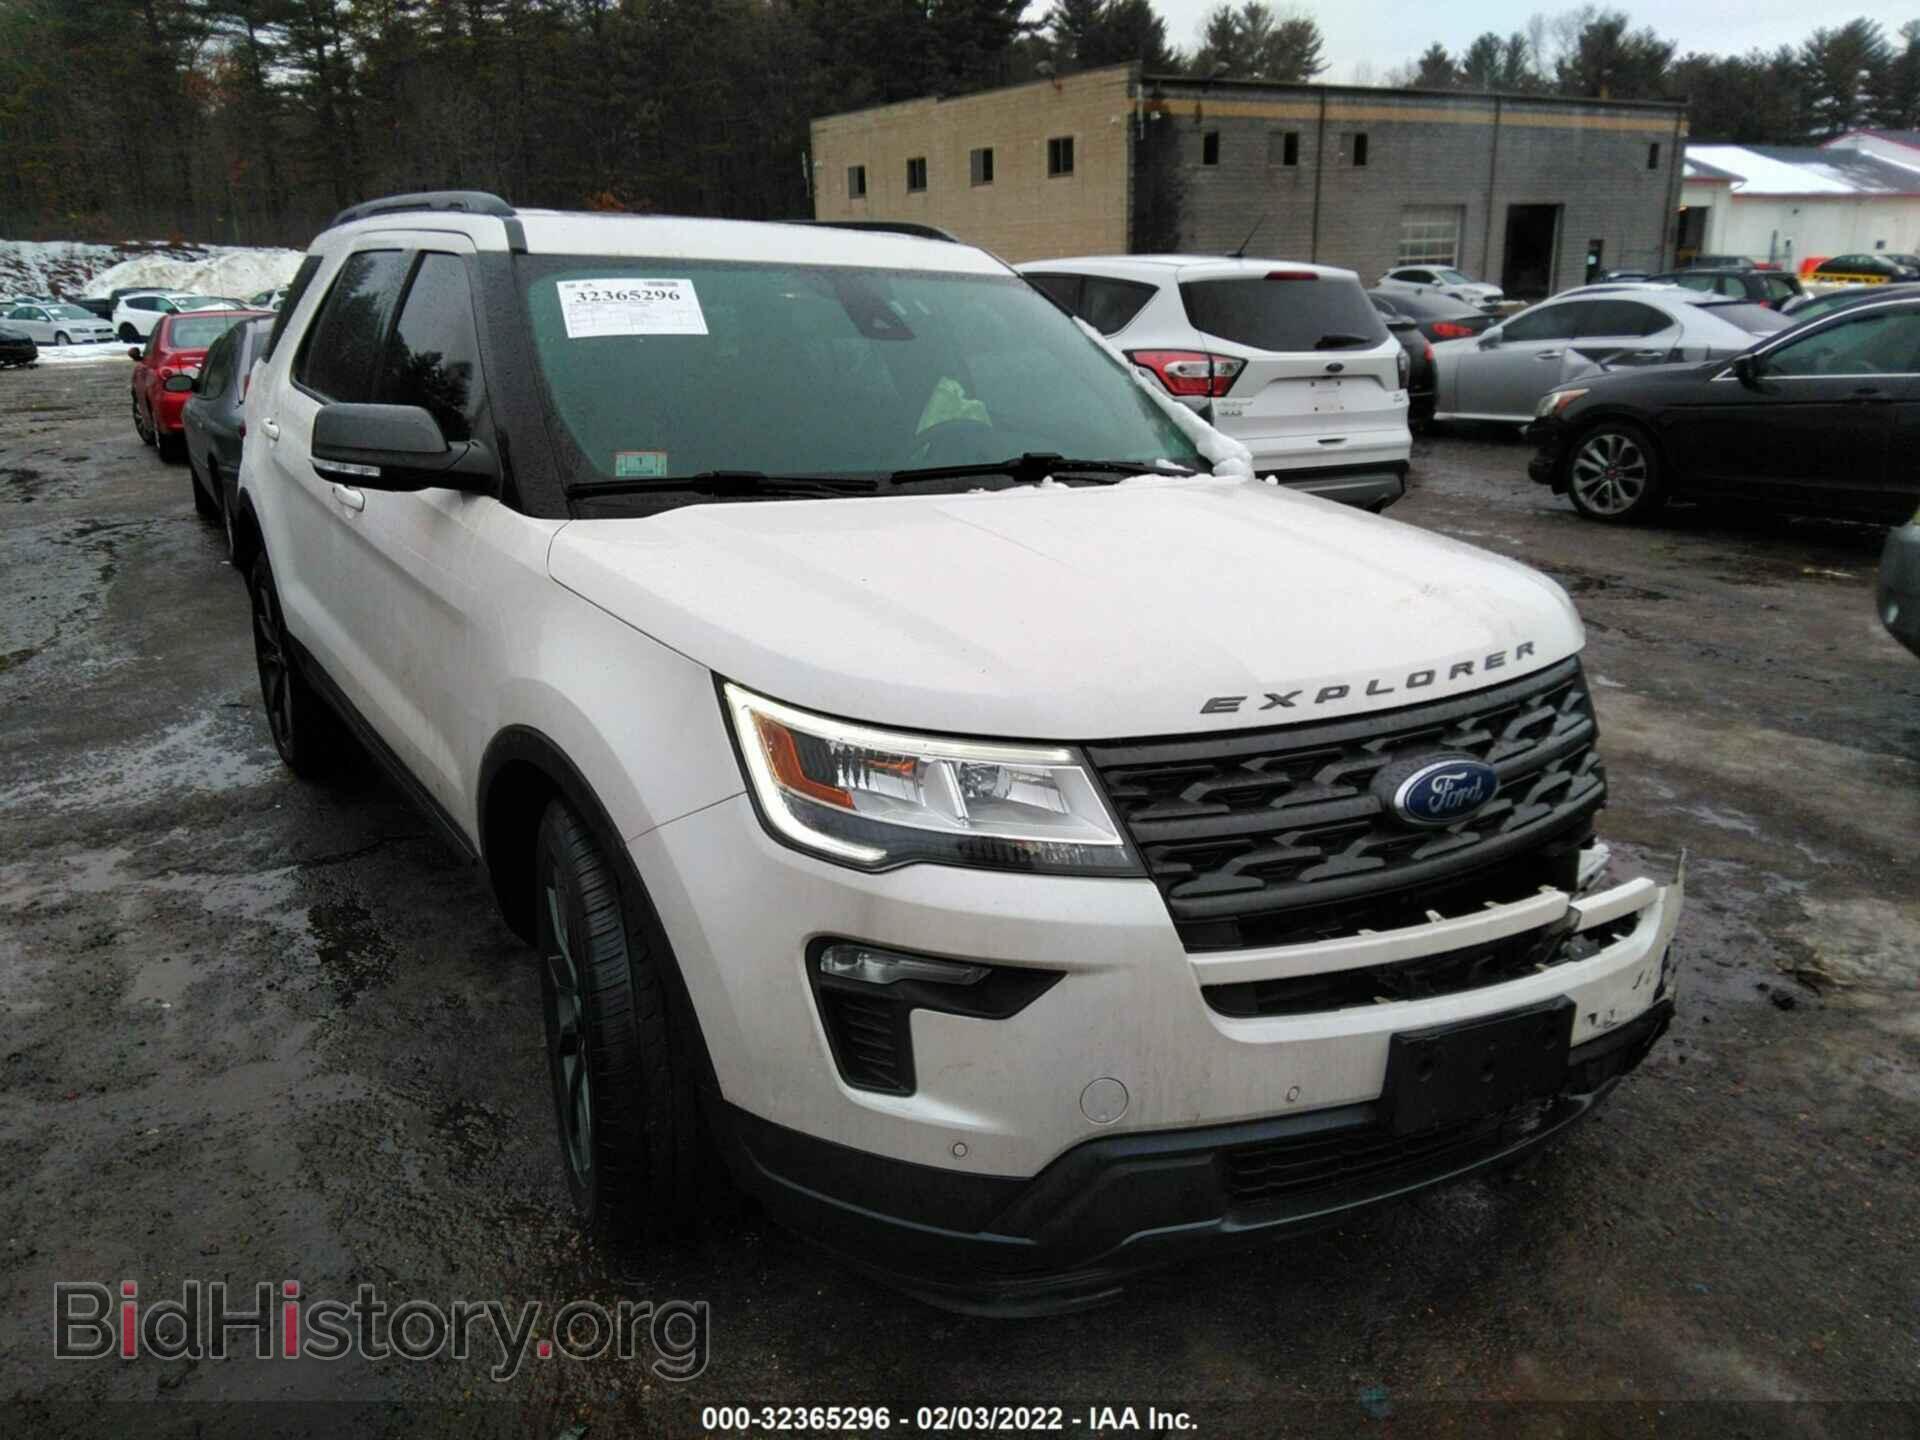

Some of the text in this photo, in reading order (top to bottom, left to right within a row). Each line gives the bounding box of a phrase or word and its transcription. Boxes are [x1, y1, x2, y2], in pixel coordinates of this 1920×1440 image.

[576, 289, 681, 303] 32365296
[1200, 641, 1536, 714] EXPLORER
[1428, 771, 1485, 813] Ford
